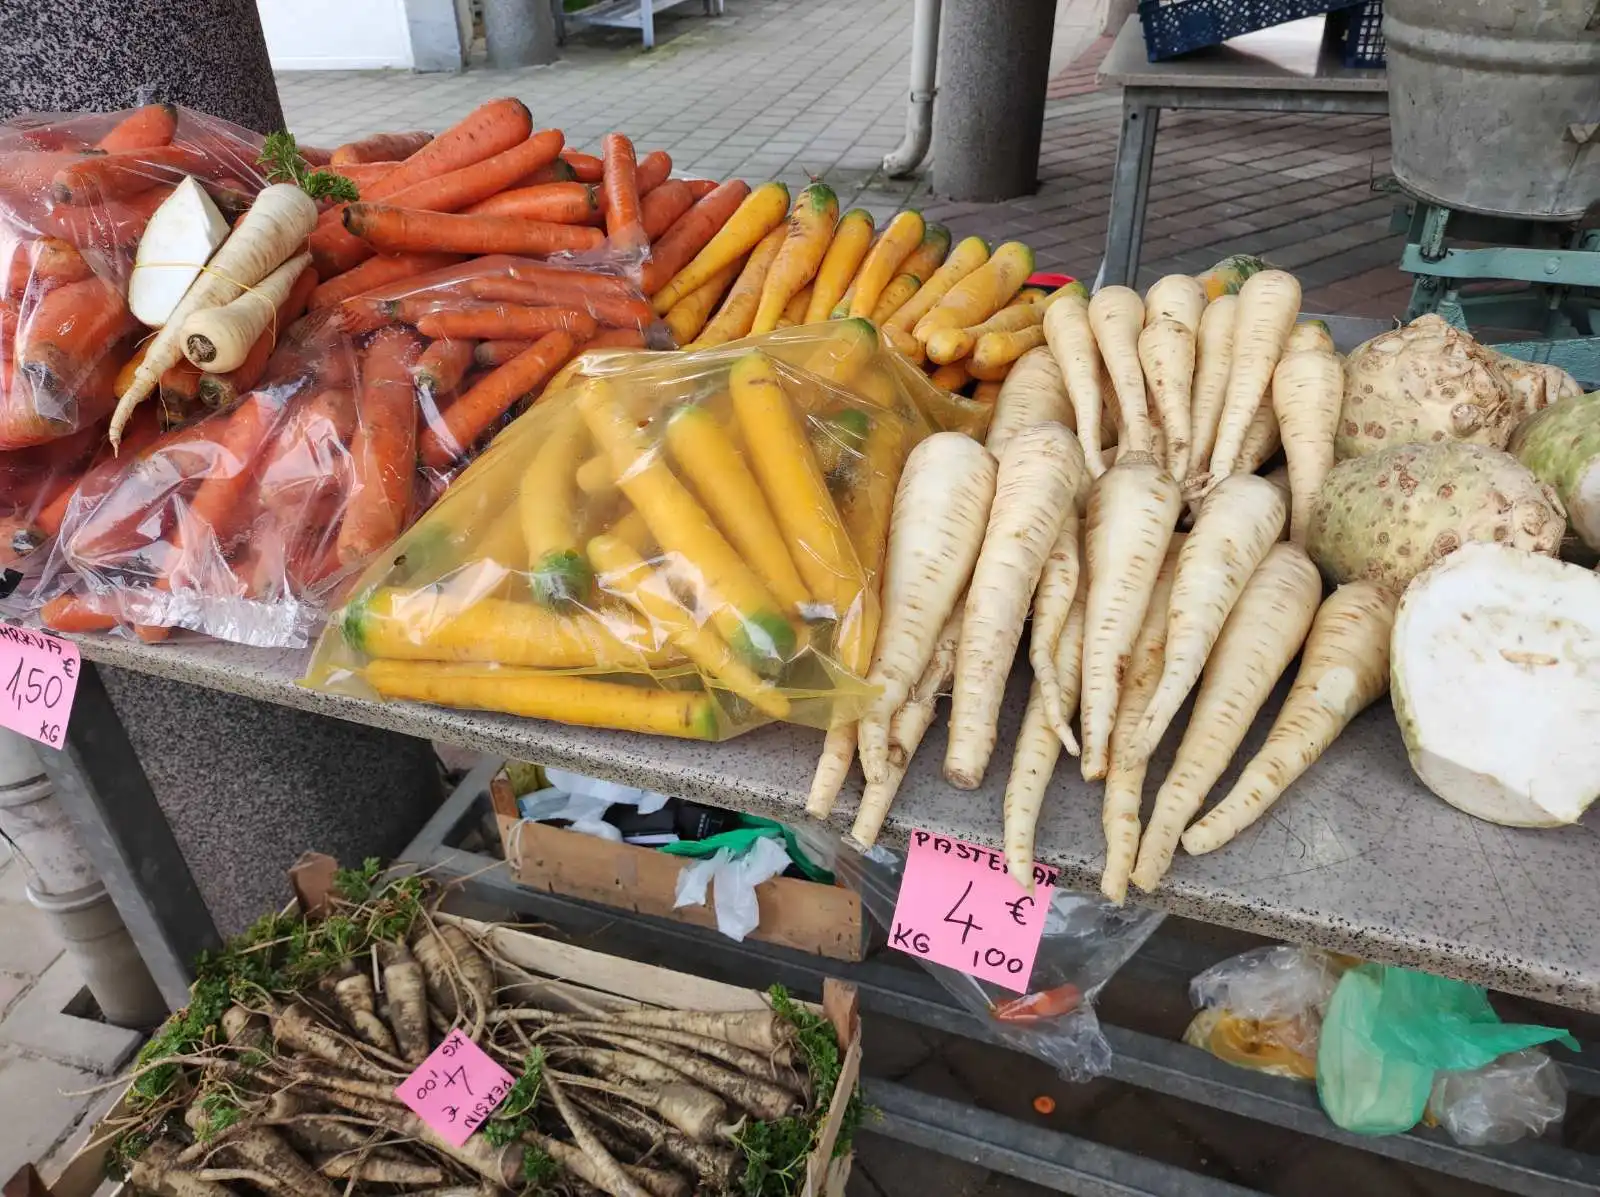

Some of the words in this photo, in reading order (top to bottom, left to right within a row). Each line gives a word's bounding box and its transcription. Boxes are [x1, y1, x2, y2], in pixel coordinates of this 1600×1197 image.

[0, 626, 62, 655] MRKVA
[6, 657, 63, 710] 1,50
[62, 657, 76, 678] €
[39, 719, 61, 743] KG
[1005, 895, 1035, 925] €
[893, 922, 931, 954] KG
[442, 1035, 465, 1057] KG
[441, 1104, 461, 1123] €
